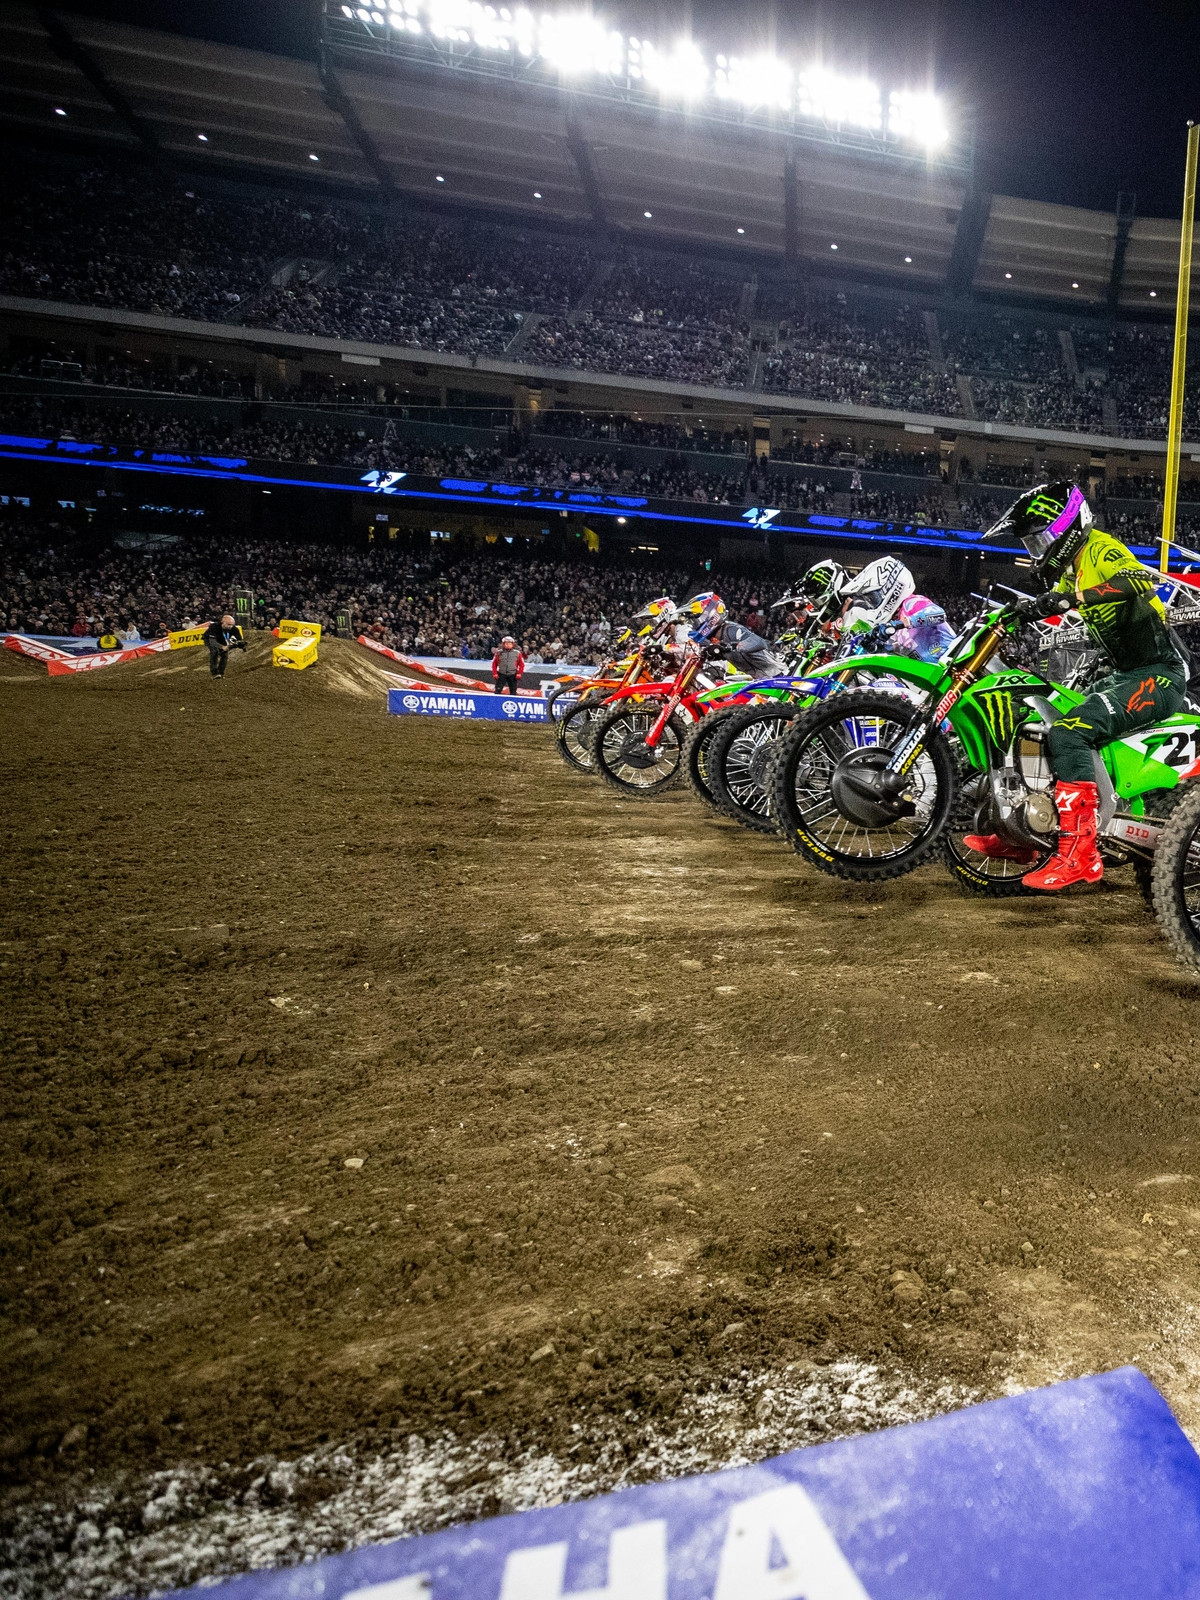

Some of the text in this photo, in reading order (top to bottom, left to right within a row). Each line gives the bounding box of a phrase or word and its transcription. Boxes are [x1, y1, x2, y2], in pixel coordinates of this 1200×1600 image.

[178, 633, 205, 644] DUN
[420, 697, 476, 711] YAMAHA
[935, 689, 958, 727] OWA
[409, 708, 472, 716] RACING
[340, 1481, 872, 1600] HA
